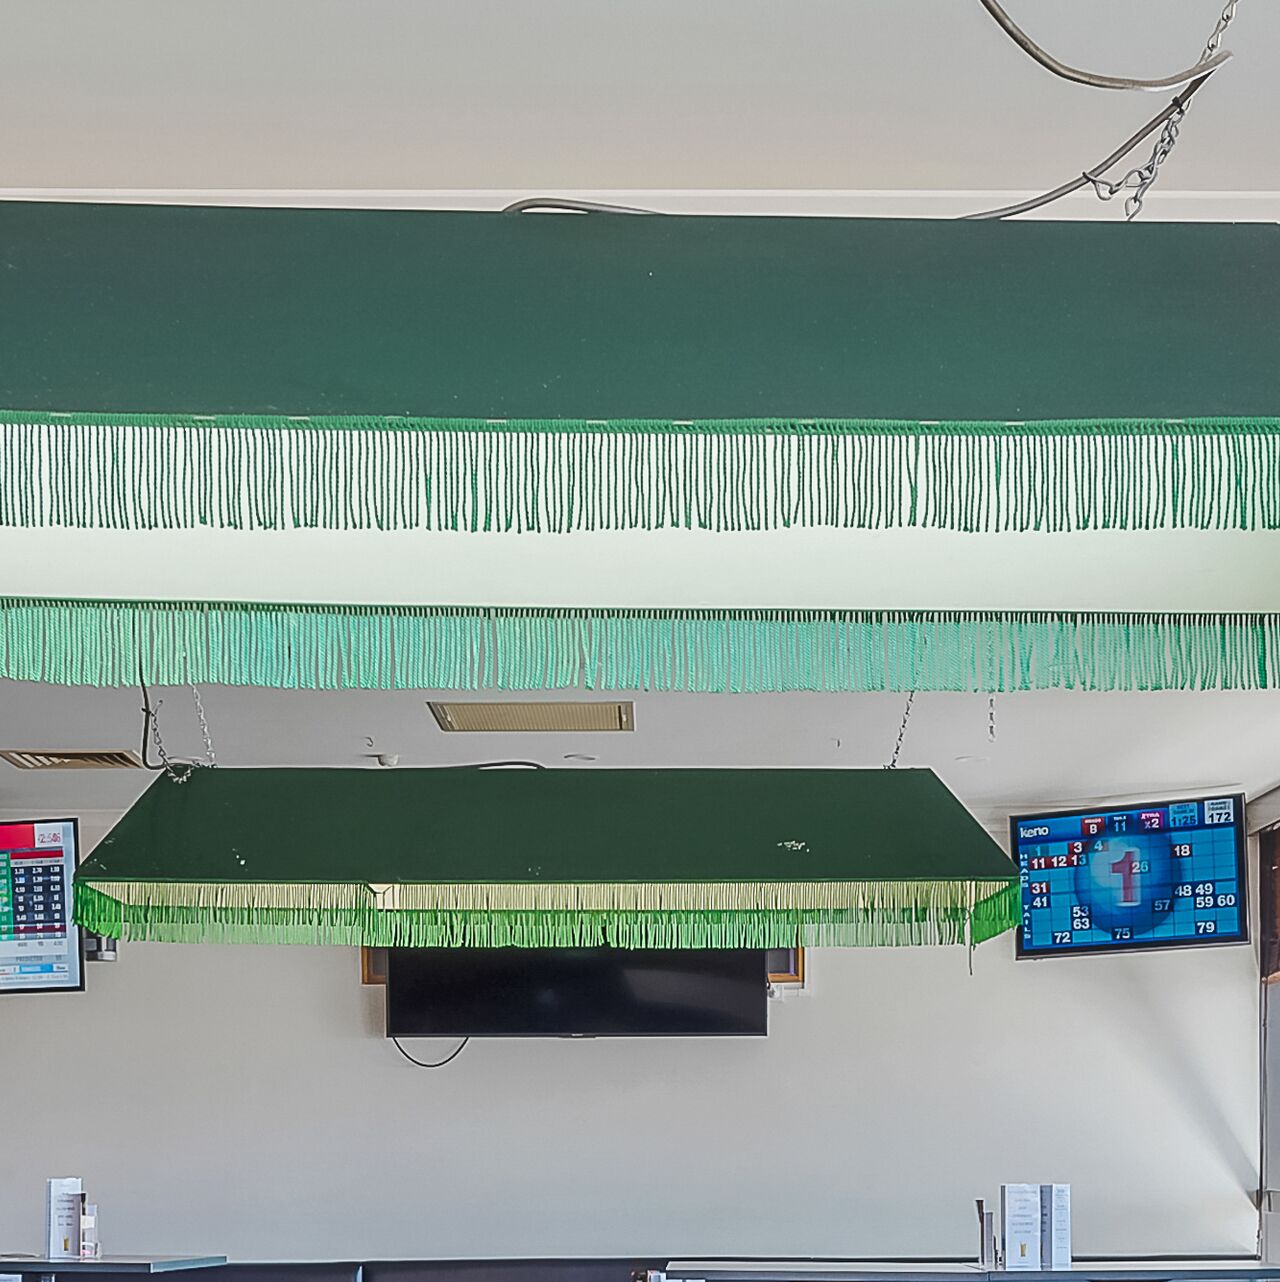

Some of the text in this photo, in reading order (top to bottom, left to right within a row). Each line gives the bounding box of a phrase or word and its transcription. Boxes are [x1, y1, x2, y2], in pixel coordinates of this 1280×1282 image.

[1208, 812, 1231, 824] 172
[1020, 826, 1049, 838] keno
[1114, 820, 1126, 832] 11
[1074, 842, 1082, 853] 3
[1094, 840, 1104, 851] 4
[1032, 844, 1191, 869] 11 12 13 18
[1132, 861, 1149, 873] 26
[1032, 882, 1047, 894] 31
[1033, 883, 1213, 908] 41 48 49
[1073, 894, 1235, 917] 53 57 59 60
[1073, 918, 1090, 930] 63
[1054, 921, 1215, 944] 72 75 79
